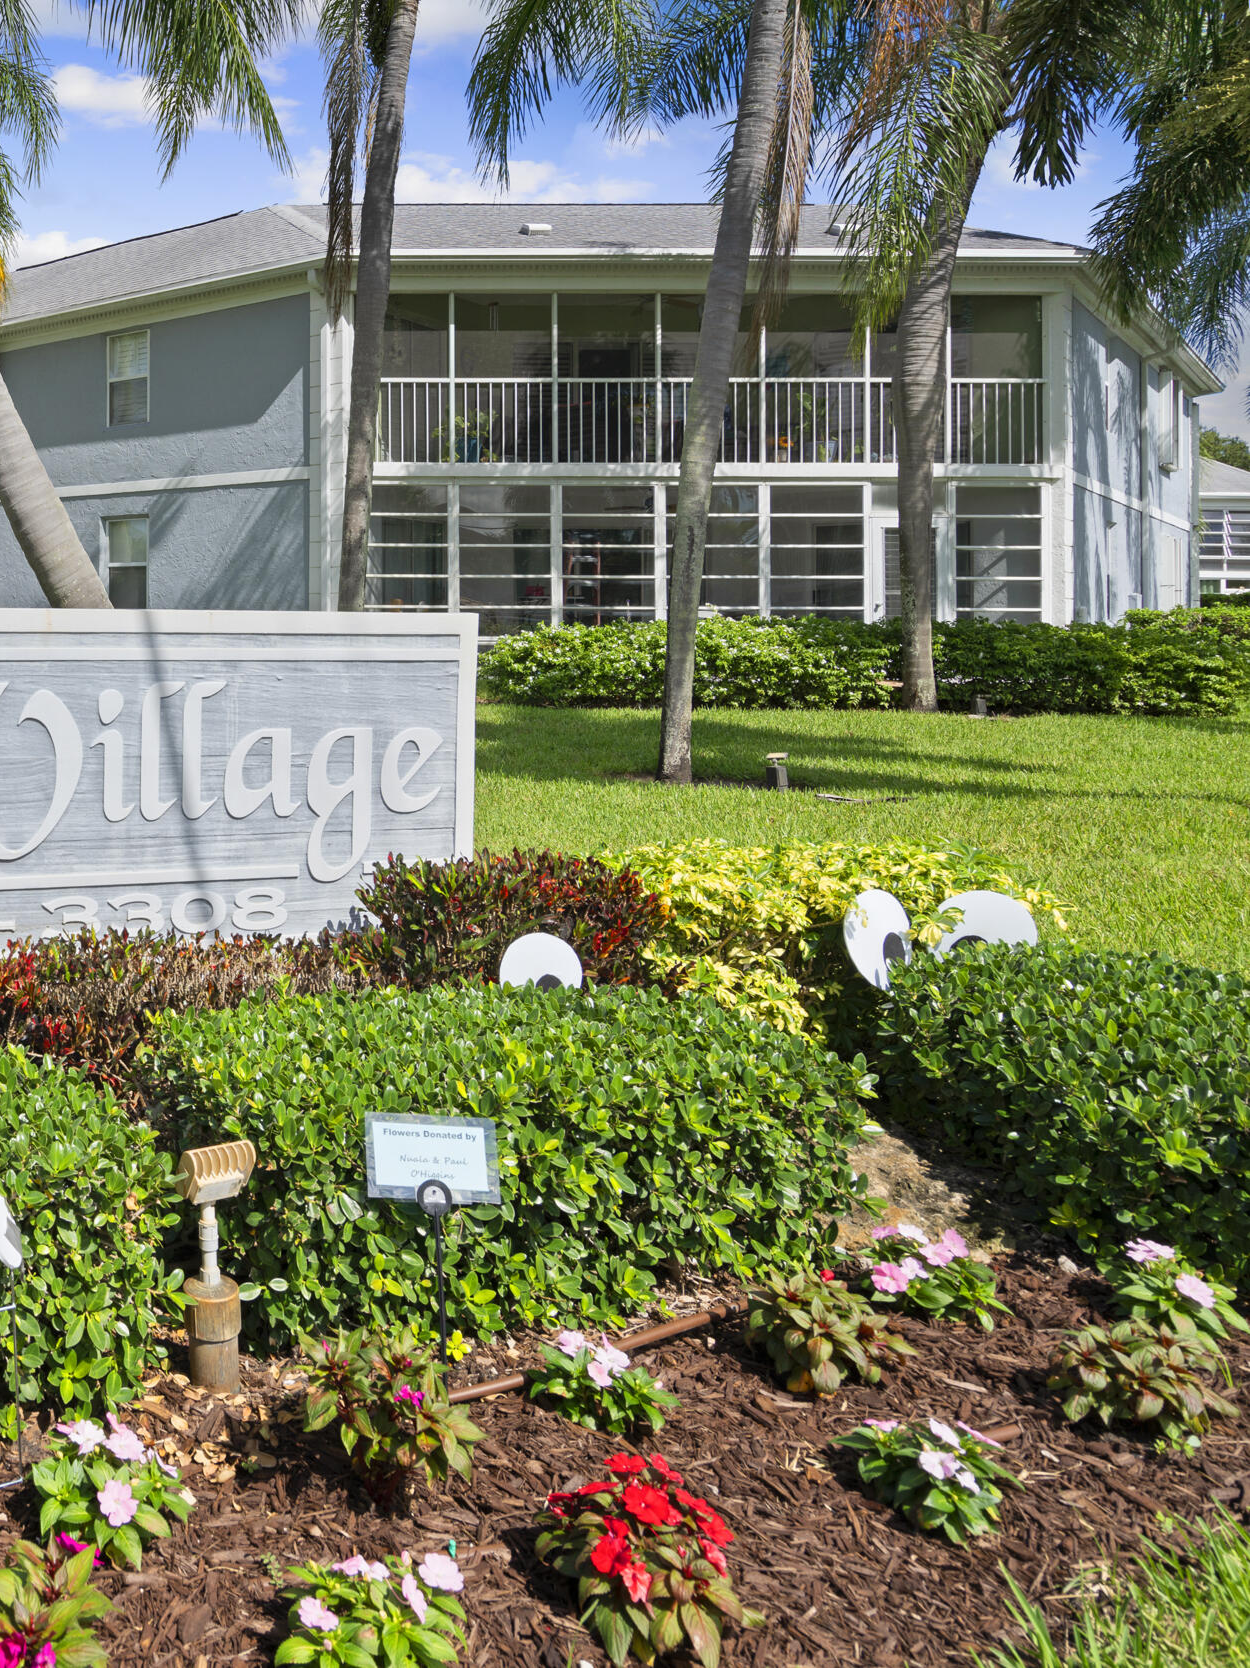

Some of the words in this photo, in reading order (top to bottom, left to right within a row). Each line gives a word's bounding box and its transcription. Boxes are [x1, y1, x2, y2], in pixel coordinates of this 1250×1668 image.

[40, 886, 289, 941] 3308
[382, 1127, 421, 1138] Flowers
[423, 1129, 463, 1140] Donated
[465, 1132, 477, 1142] by
[444, 1156, 469, 1165] Paul
